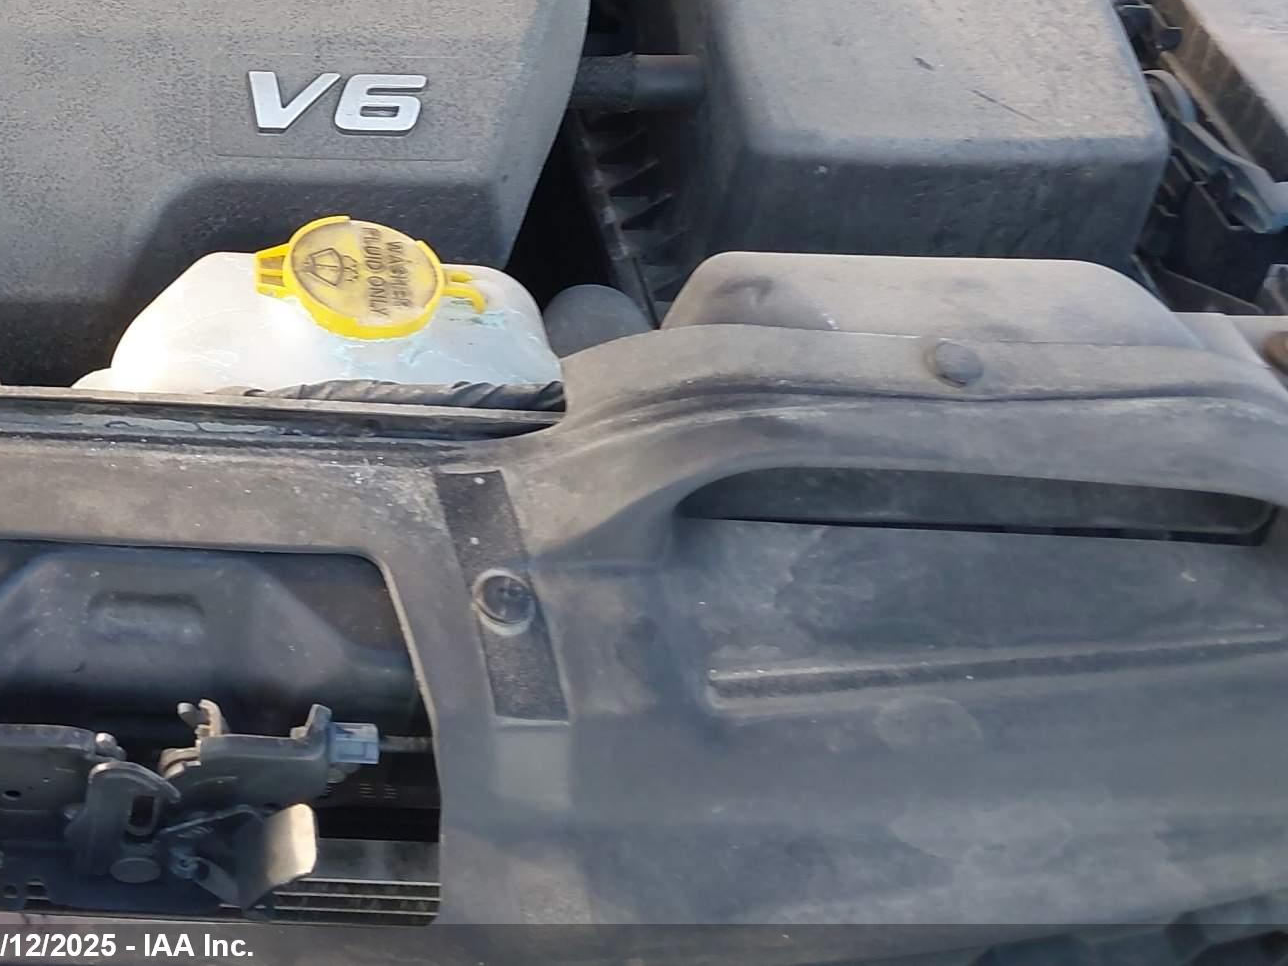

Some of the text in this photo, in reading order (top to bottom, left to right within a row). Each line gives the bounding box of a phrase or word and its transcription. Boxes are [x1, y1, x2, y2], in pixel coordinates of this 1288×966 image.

[248, 71, 428, 135] V6
[362, 227, 389, 316] FLUID ONLY
[386, 241, 412, 308] WASHER
